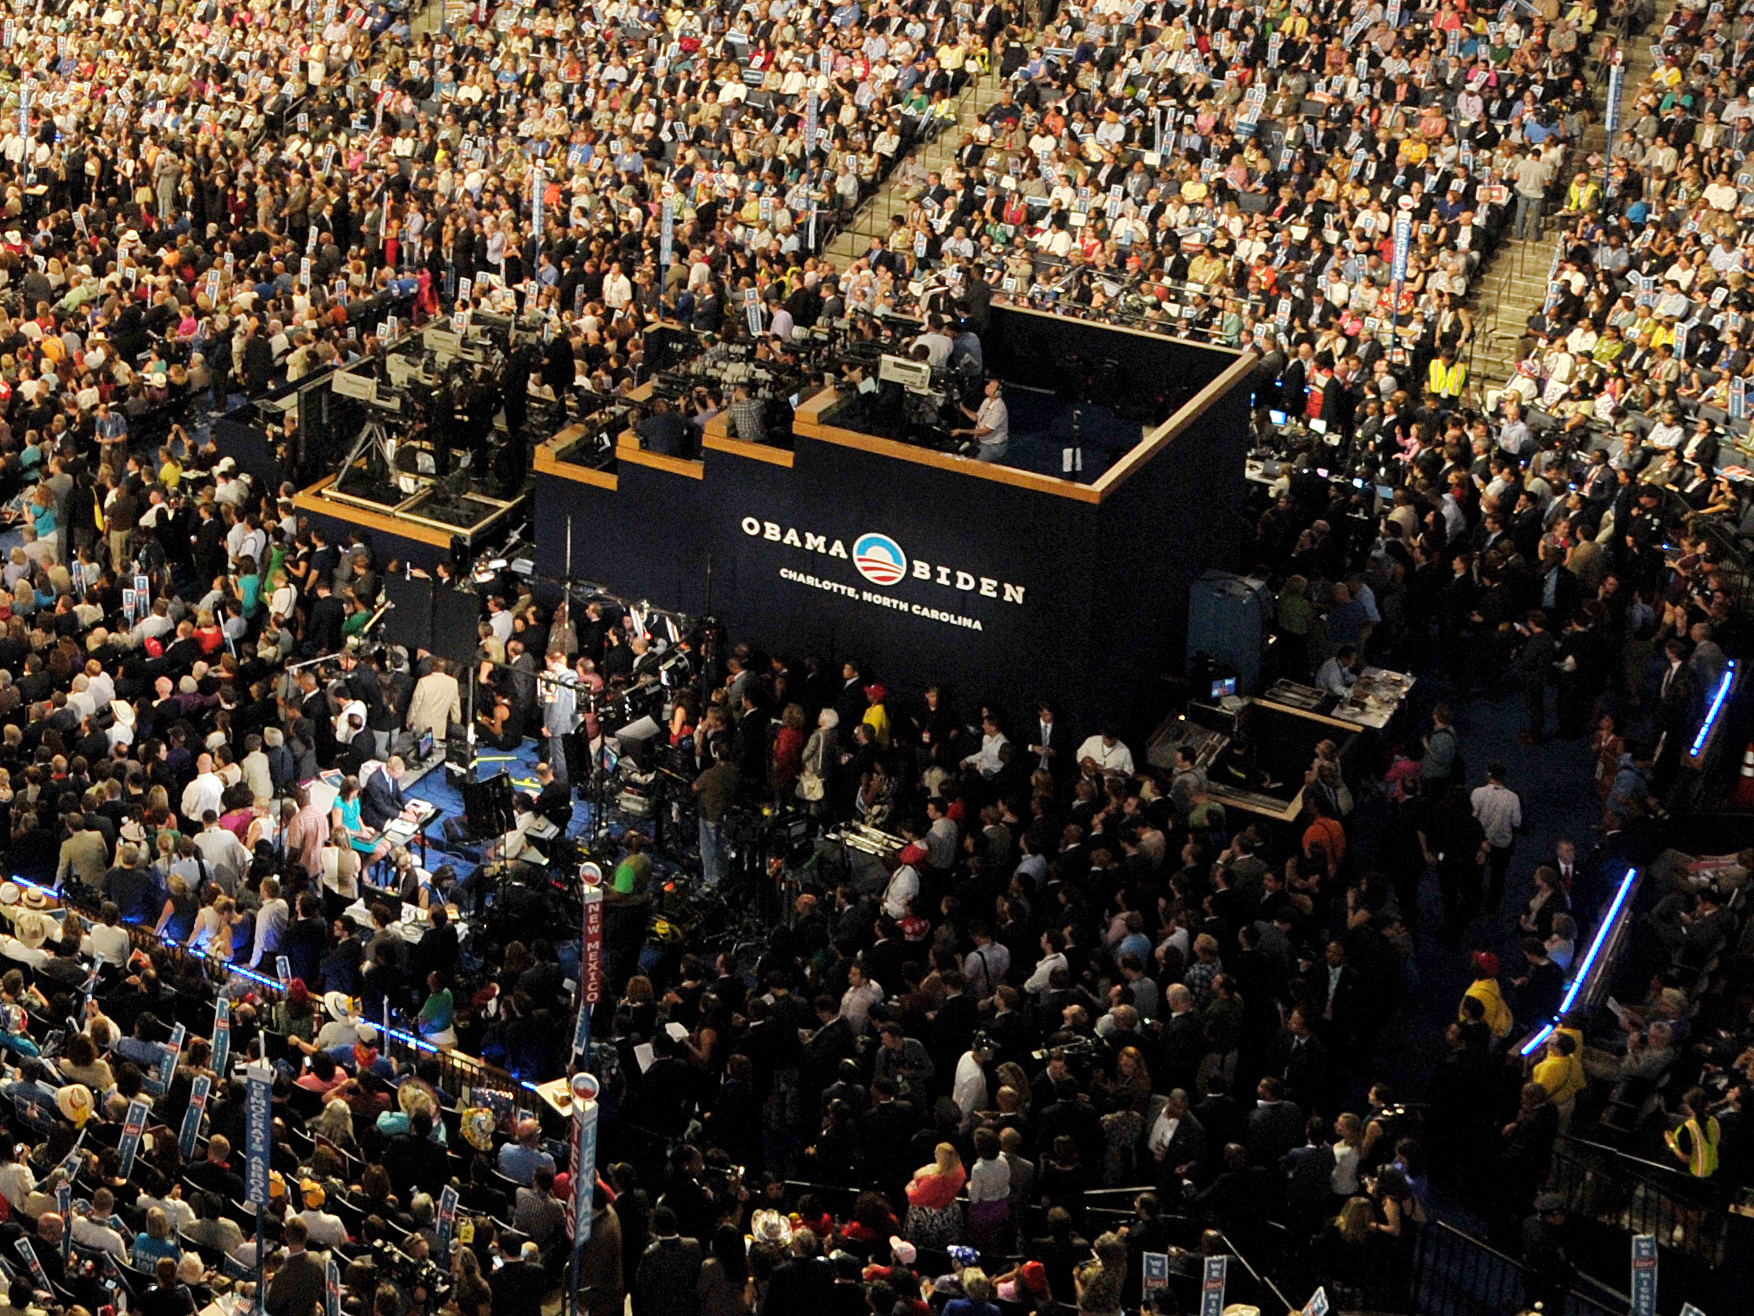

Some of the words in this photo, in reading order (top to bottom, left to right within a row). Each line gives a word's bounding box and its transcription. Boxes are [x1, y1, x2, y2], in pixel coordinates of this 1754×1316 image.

[741, 516, 848, 560] OBAMA
[912, 559, 1025, 605] BIDEN
[779, 567, 860, 600] CHARLOTTE,
[862, 591, 909, 612] NORTH
[911, 604, 983, 631] CAROLINA
[586, 903, 601, 934] NEW
[585, 940, 600, 1002] MEXICO
[249, 1081, 266, 1154] DEMOCRATS
[249, 1156, 266, 1203] ABROAD
[565, 1119, 581, 1240] TEXAS
[577, 1122, 596, 1241] TEXAS
